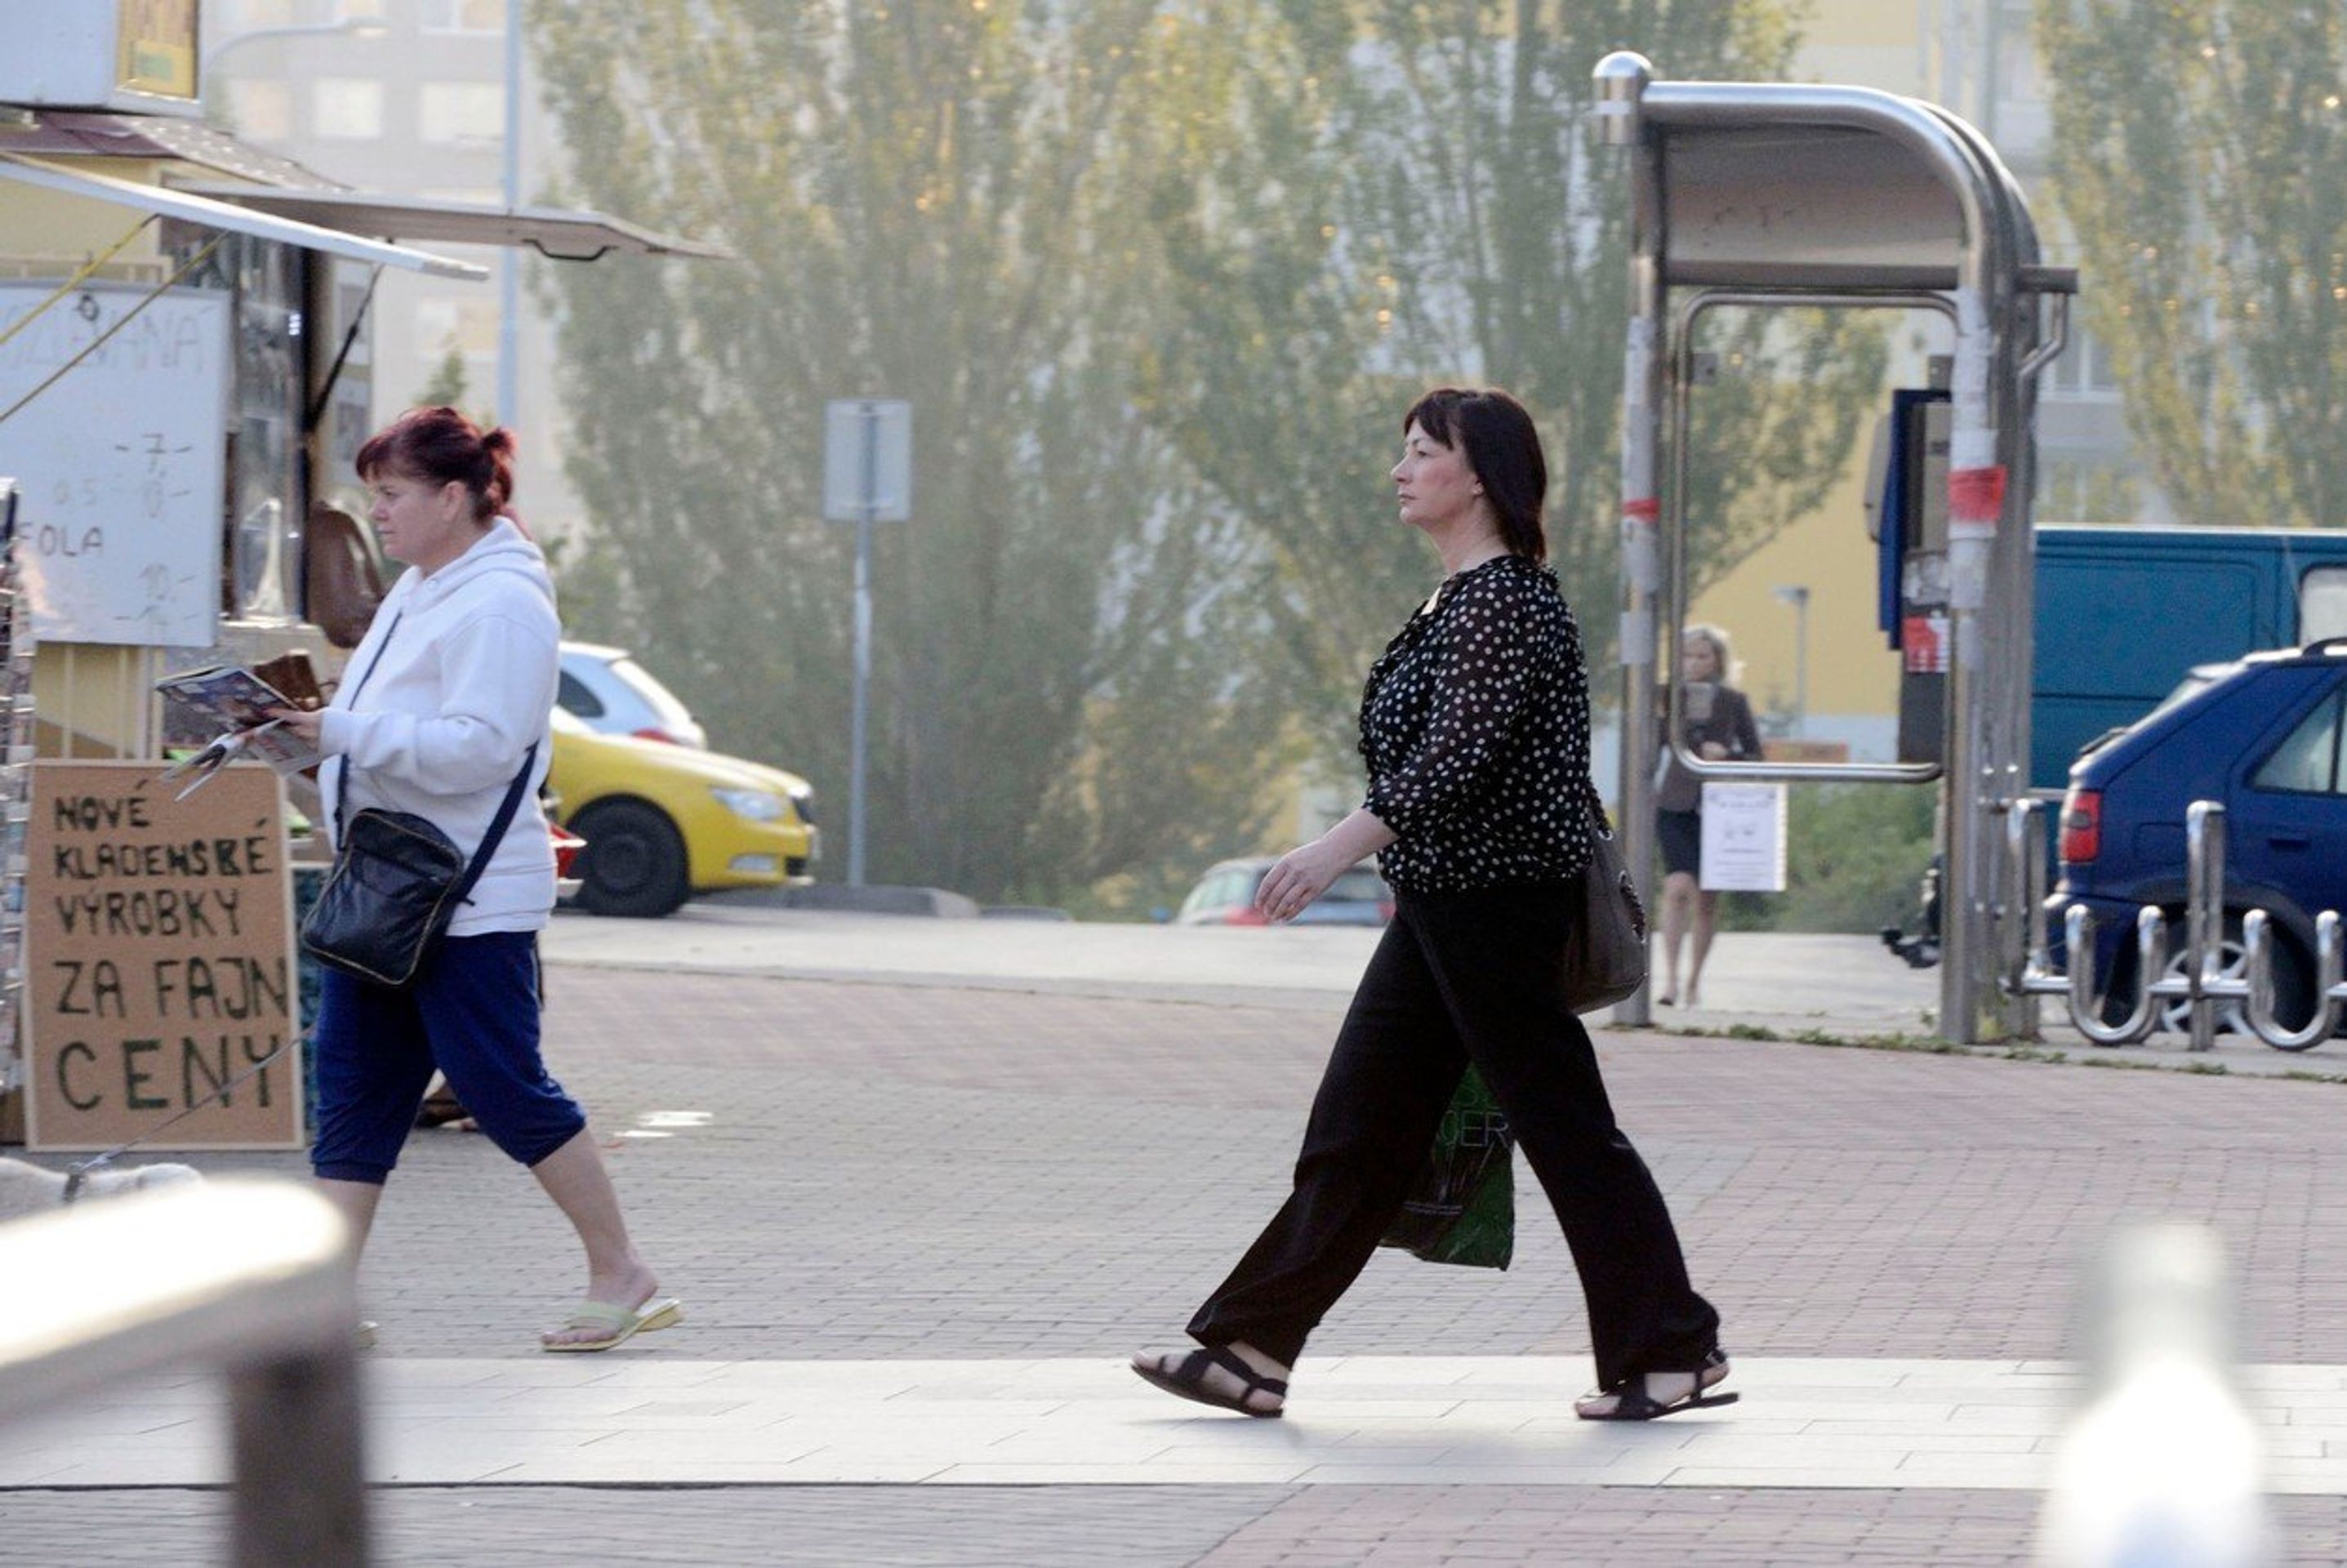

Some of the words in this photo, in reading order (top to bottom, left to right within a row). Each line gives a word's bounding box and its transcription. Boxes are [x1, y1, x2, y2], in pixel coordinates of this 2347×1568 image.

[54, 779, 151, 831] NOVÉ
[54, 818, 272, 880] KLADENSKÉ
[55, 886, 241, 938] VÝROBKY
[53, 959, 127, 1018] ZA
[154, 956, 288, 1020] FAJN
[56, 1033, 279, 1111] CENY
